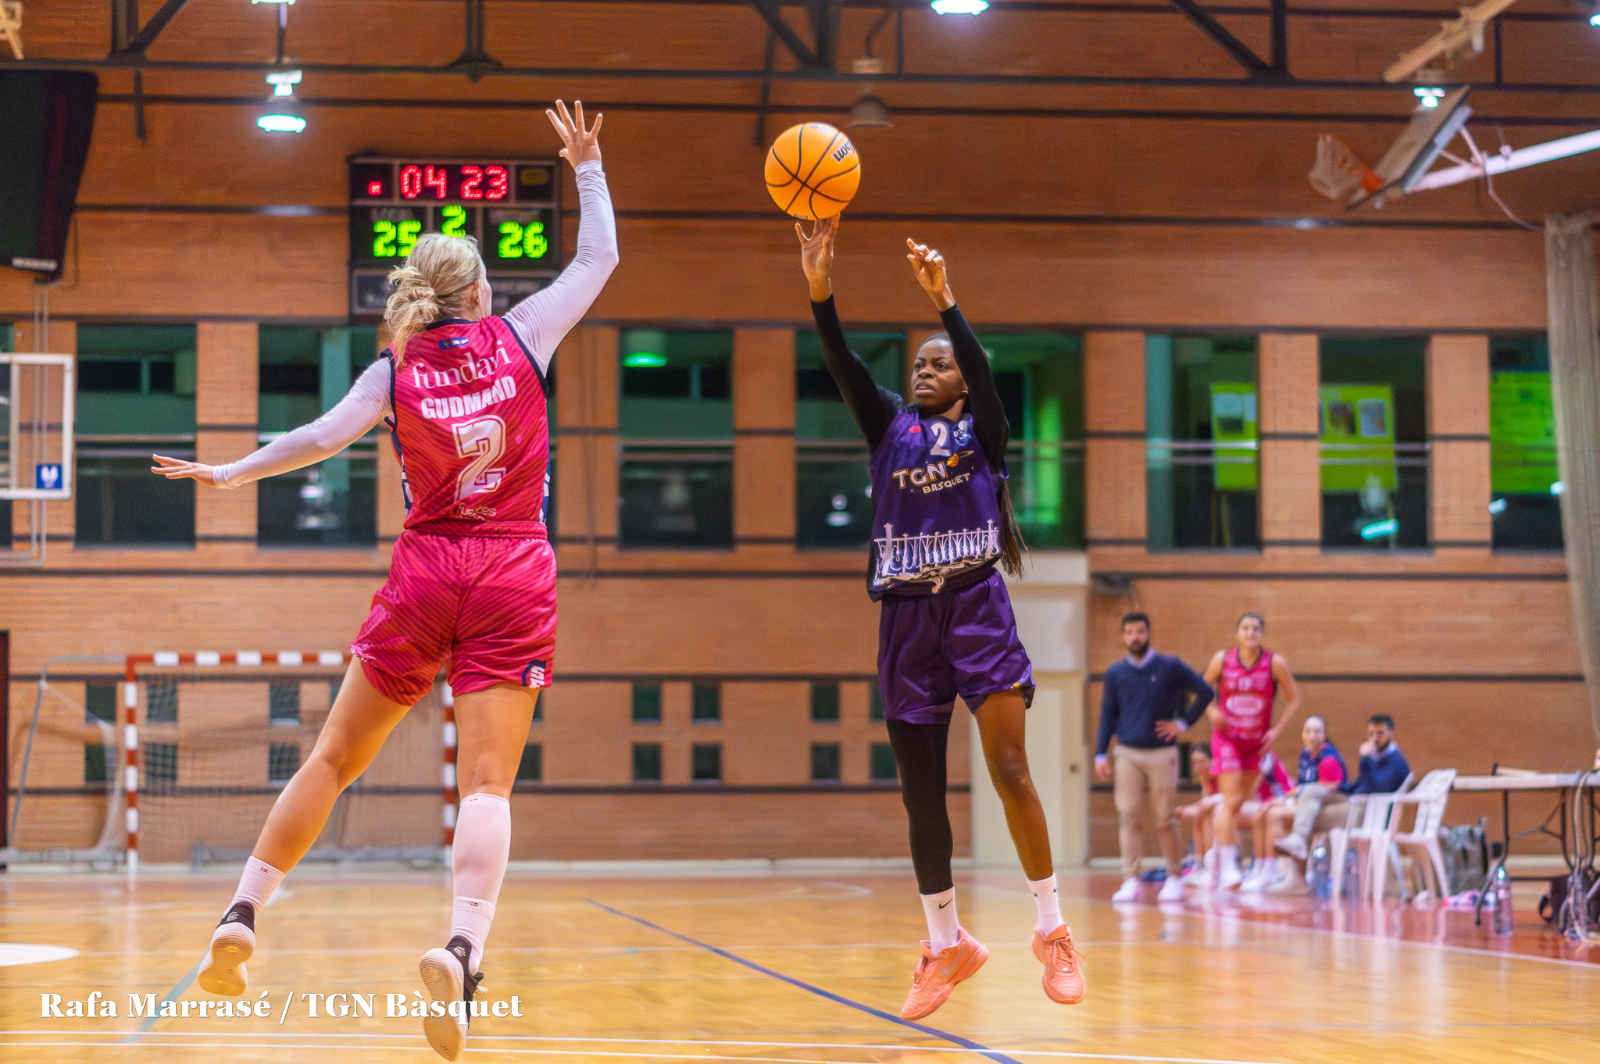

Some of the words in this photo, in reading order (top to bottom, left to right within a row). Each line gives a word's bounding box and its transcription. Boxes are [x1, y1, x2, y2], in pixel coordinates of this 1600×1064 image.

[400, 165, 447, 199] 04
[461, 165, 508, 200] 23
[373, 220, 422, 258] 25
[441, 204, 467, 238] 2
[498, 221, 548, 259] 26
[410, 340, 513, 390] fundavi
[421, 375, 517, 420] GUDMAND
[930, 422, 951, 457] 2
[451, 414, 507, 503] 2
[892, 461, 949, 489] TGN
[922, 472, 971, 494] BASQUET
